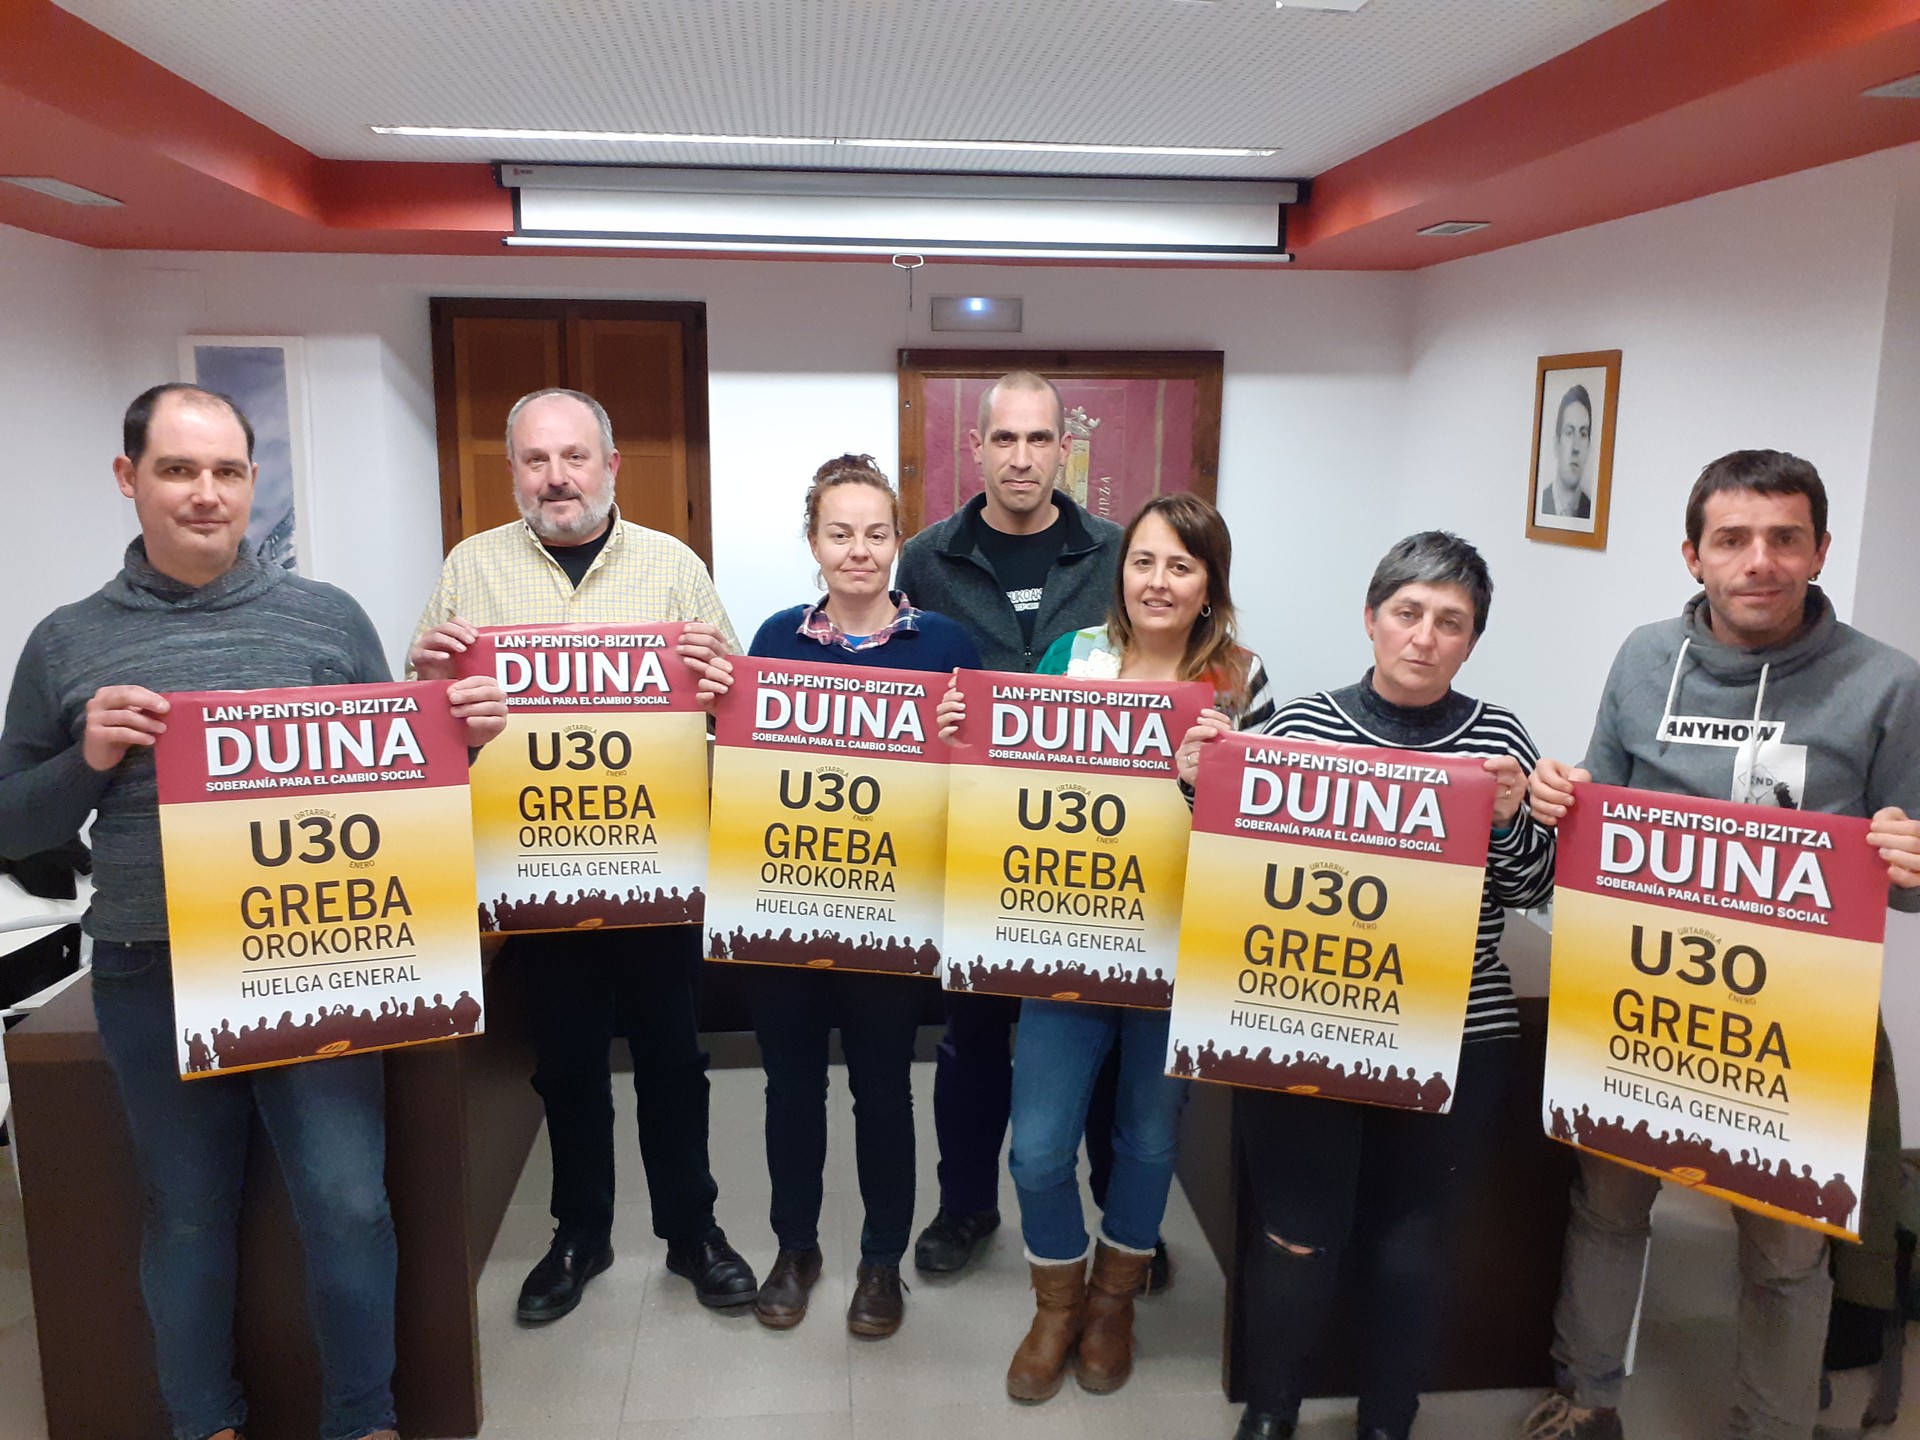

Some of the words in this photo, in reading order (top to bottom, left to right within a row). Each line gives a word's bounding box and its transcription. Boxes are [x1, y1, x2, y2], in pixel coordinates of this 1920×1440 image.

[494, 635, 665, 648] LAN-PENTSIO-BIZITZA
[495, 652, 670, 693] DUINA
[758, 671, 925, 696] LAN-PENTSIO-BIZITZA
[203, 698, 418, 722] LAN-PENTSIO-BIZITZA
[505, 695, 551, 705] BERANÍA
[553, 697, 578, 705] PARA
[580, 696, 592, 705] EL
[593, 696, 631, 705] CAMBIO
[634, 696, 669, 704] SOCIAL
[755, 688, 925, 741] DUINA
[993, 686, 1172, 708] LAN-PENTSIO-BIZITZA
[205, 718, 426, 776] DUINA
[752, 732, 807, 744] SOBERANÍA
[809, 737, 833, 746] PARA
[835, 739, 847, 747] EL
[848, 741, 886, 751] CAMBIO
[888, 744, 923, 754] SOCIAL
[992, 703, 1172, 756] DUINA
[1666, 721, 1777, 742] ANYHOW
[528, 731, 631, 771] U30
[989, 749, 1044, 760] SOBERANÍA
[1048, 754, 1073, 763] PARA
[1076, 756, 1087, 764] EL
[1089, 757, 1130, 767] CAMBIO
[1132, 759, 1170, 770] SOCIAL
[1245, 747, 1448, 784] LAN-PENTSIO-BIZITZA
[206, 777, 277, 791] SOBERANÍA
[280, 777, 311, 787] PARA
[314, 776, 329, 785] EL
[331, 773, 378, 784] CAMBIO
[381, 770, 425, 781] SOCIAL
[780, 770, 880, 815] U30
[519, 785, 656, 821] GREBA
[1018, 788, 1125, 836] U30
[1239, 767, 1446, 838] DUINA
[250, 814, 380, 867] U30
[519, 824, 657, 847] OROKORRA
[1235, 818, 1299, 835] SOBERANÍA
[1302, 827, 1331, 839] PARA
[1334, 831, 1348, 841] EL
[1350, 833, 1396, 847] CAMBIO
[1400, 839, 1442, 853] SOCIAL
[1602, 801, 1832, 849] LAN-PENTSIO-BIZITZA
[349, 860, 375, 869] ENERO
[765, 823, 897, 867] GREBA
[518, 863, 582, 877] HUELGA
[586, 861, 661, 875] GENERAL
[762, 862, 895, 892] OROKORRA
[1003, 845, 1145, 893] GREBA
[1601, 822, 1832, 908] DUINA
[241, 876, 412, 930] GREBA
[756, 898, 818, 916] HUELGA
[823, 903, 896, 922] GENERAL
[1001, 887, 1144, 921] OROKORRA
[1264, 863, 1387, 921] U30
[1596, 875, 1664, 897] SOBERANÍA
[1668, 888, 1700, 903] PARA
[1703, 894, 1718, 906] EL
[1721, 897, 1774, 915] CAMBIO
[1777, 906, 1828, 925] SOCIAL
[242, 922, 415, 961] OROKORRA
[996, 926, 1062, 946] HUELGA
[1067, 932, 1146, 952] GENERAL
[1244, 924, 1403, 985] GREBA
[1631, 925, 1766, 995] U30
[242, 974, 323, 998] HUELGA
[329, 965, 421, 989] GENERAL
[1238, 969, 1400, 1015] OROKORRA
[1230, 1010, 1305, 1035] HUELGA
[1311, 1022, 1398, 1049] GENERAL
[1613, 988, 1791, 1070] GREBA
[1609, 1035, 1789, 1102] OROKORRA
[1604, 1076, 1683, 1113] HUELGA
[1689, 1100, 1790, 1141] GENERAL
